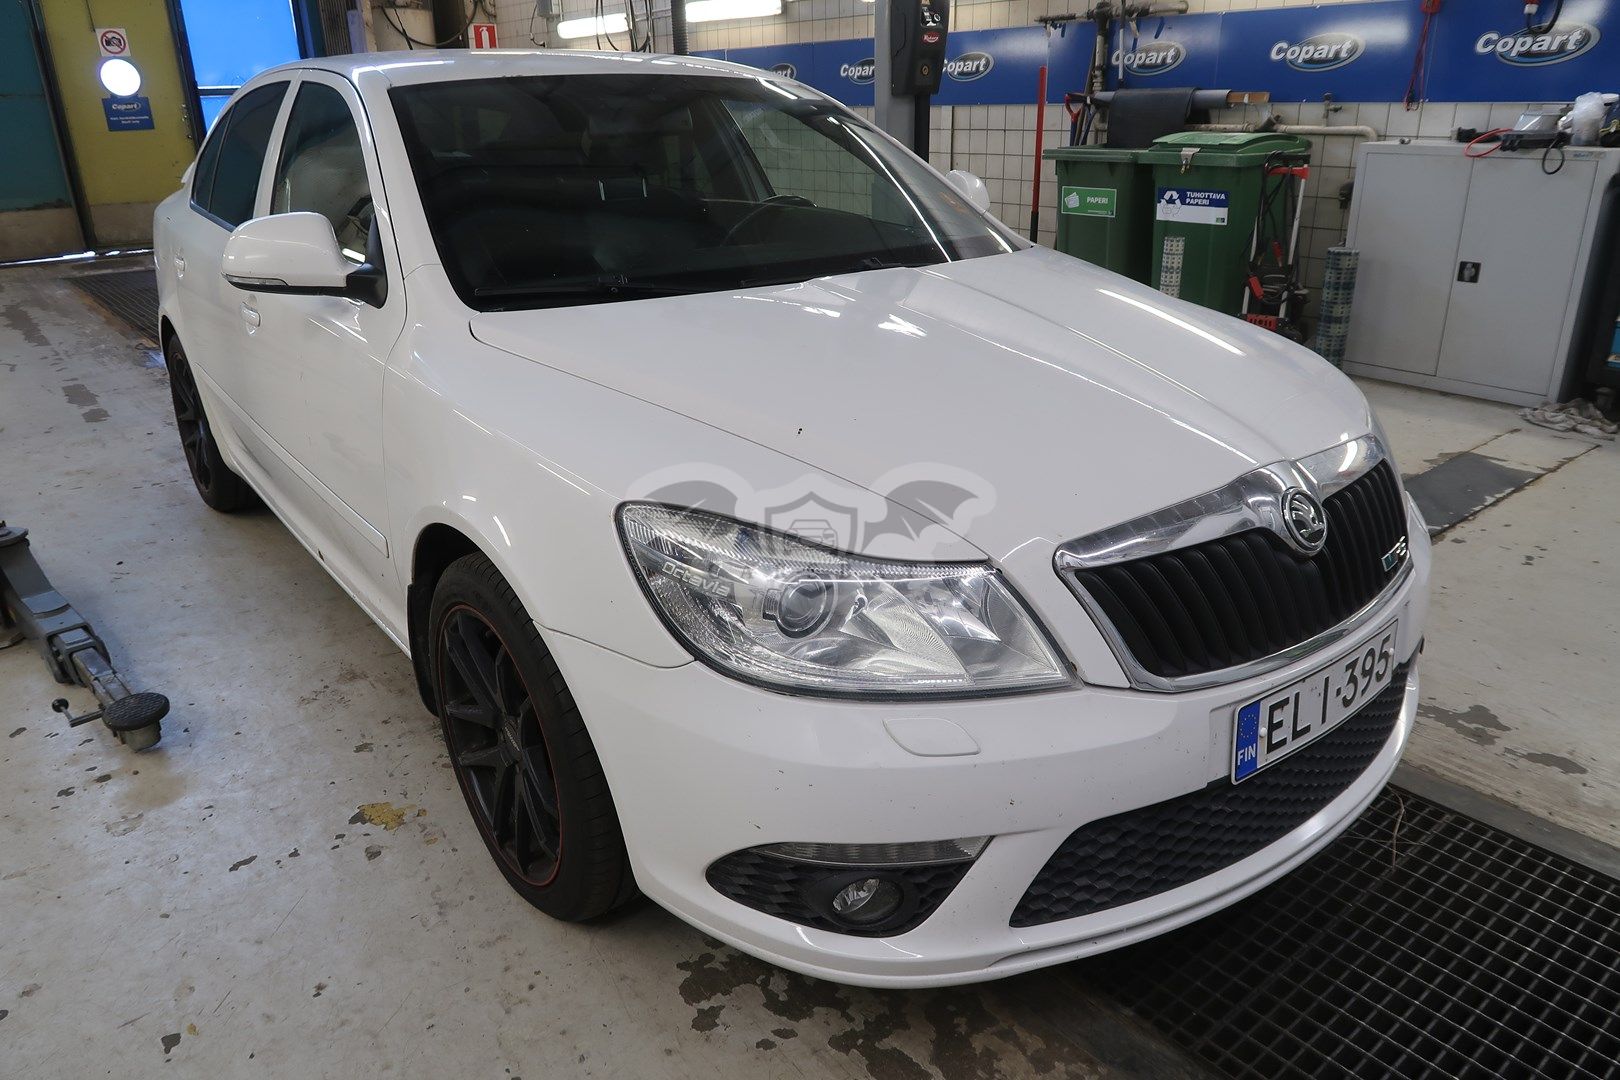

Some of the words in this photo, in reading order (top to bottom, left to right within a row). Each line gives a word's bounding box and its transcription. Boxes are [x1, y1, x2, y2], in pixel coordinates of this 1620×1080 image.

[1270, 41, 1353, 61] Copart
[1476, 26, 1583, 58] Copart
[1111, 47, 1177, 67] Copart
[840, 64, 875, 78] Copar
[1086, 196, 1108, 204] PAPERI
[1186, 191, 1226, 200] TUHOTTAVA
[1238, 743, 1256, 765] FIN
